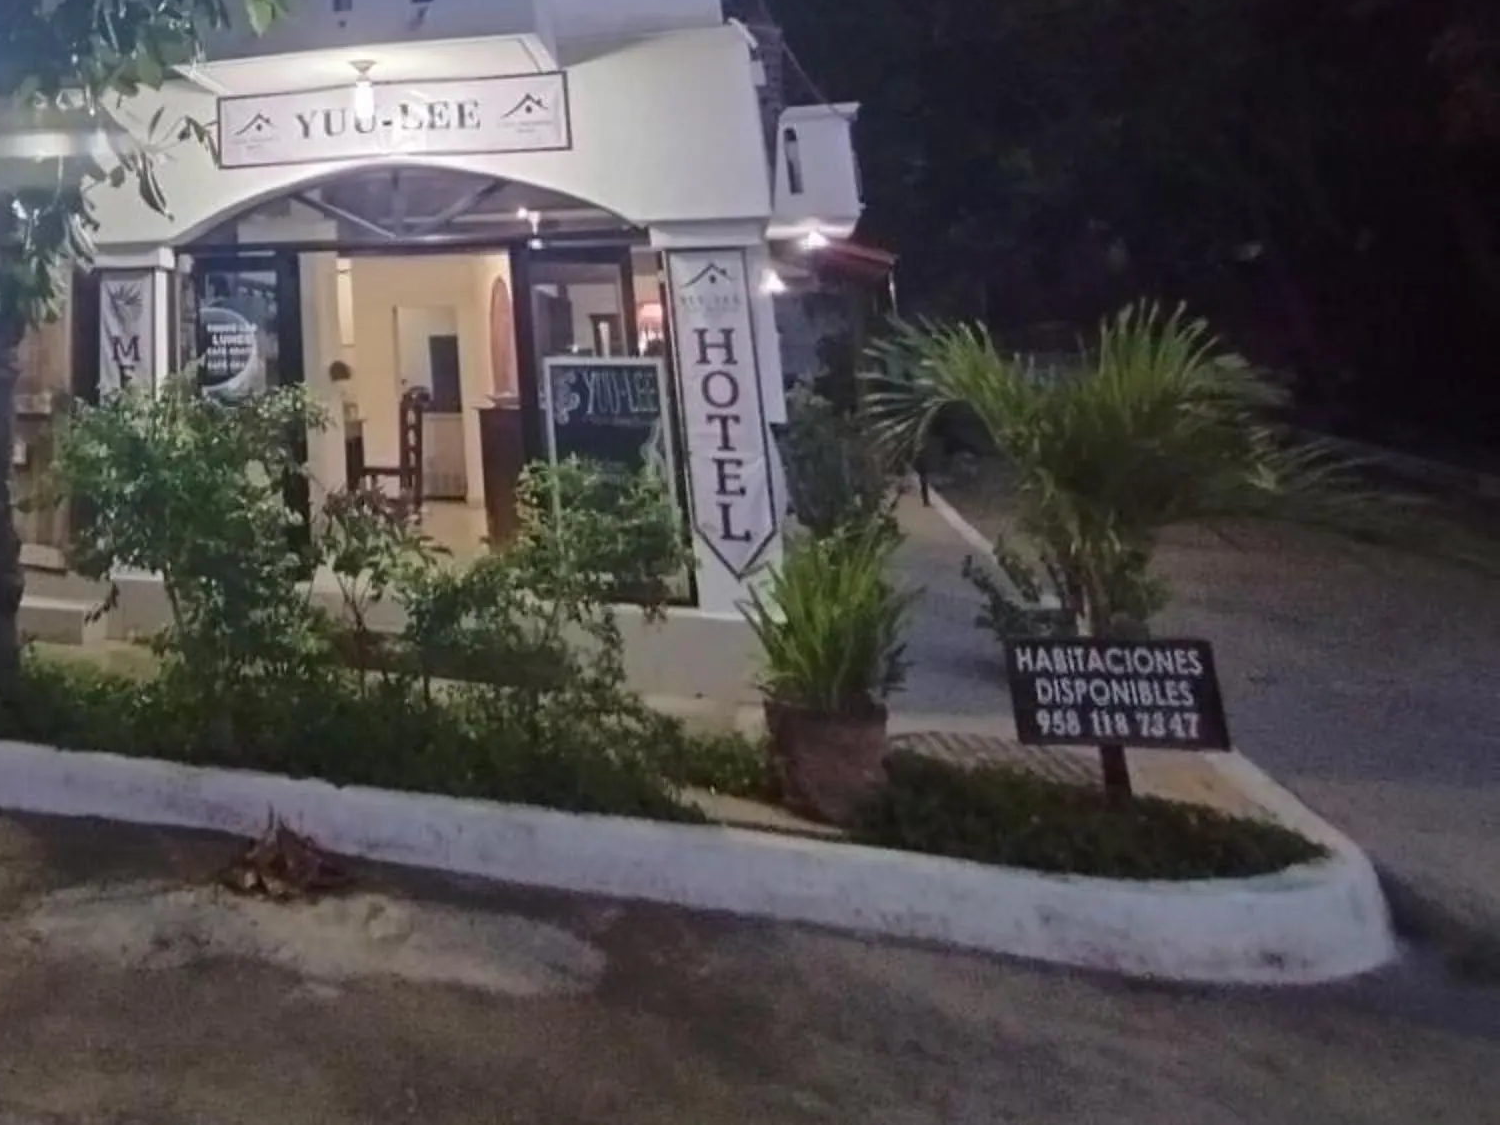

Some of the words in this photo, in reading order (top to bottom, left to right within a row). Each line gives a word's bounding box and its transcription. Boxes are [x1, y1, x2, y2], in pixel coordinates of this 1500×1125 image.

[694, 328, 751, 542] HOTEL
[1015, 646, 1204, 675] HABITACIONES
[1035, 678, 1195, 707] DISPONIBLES
